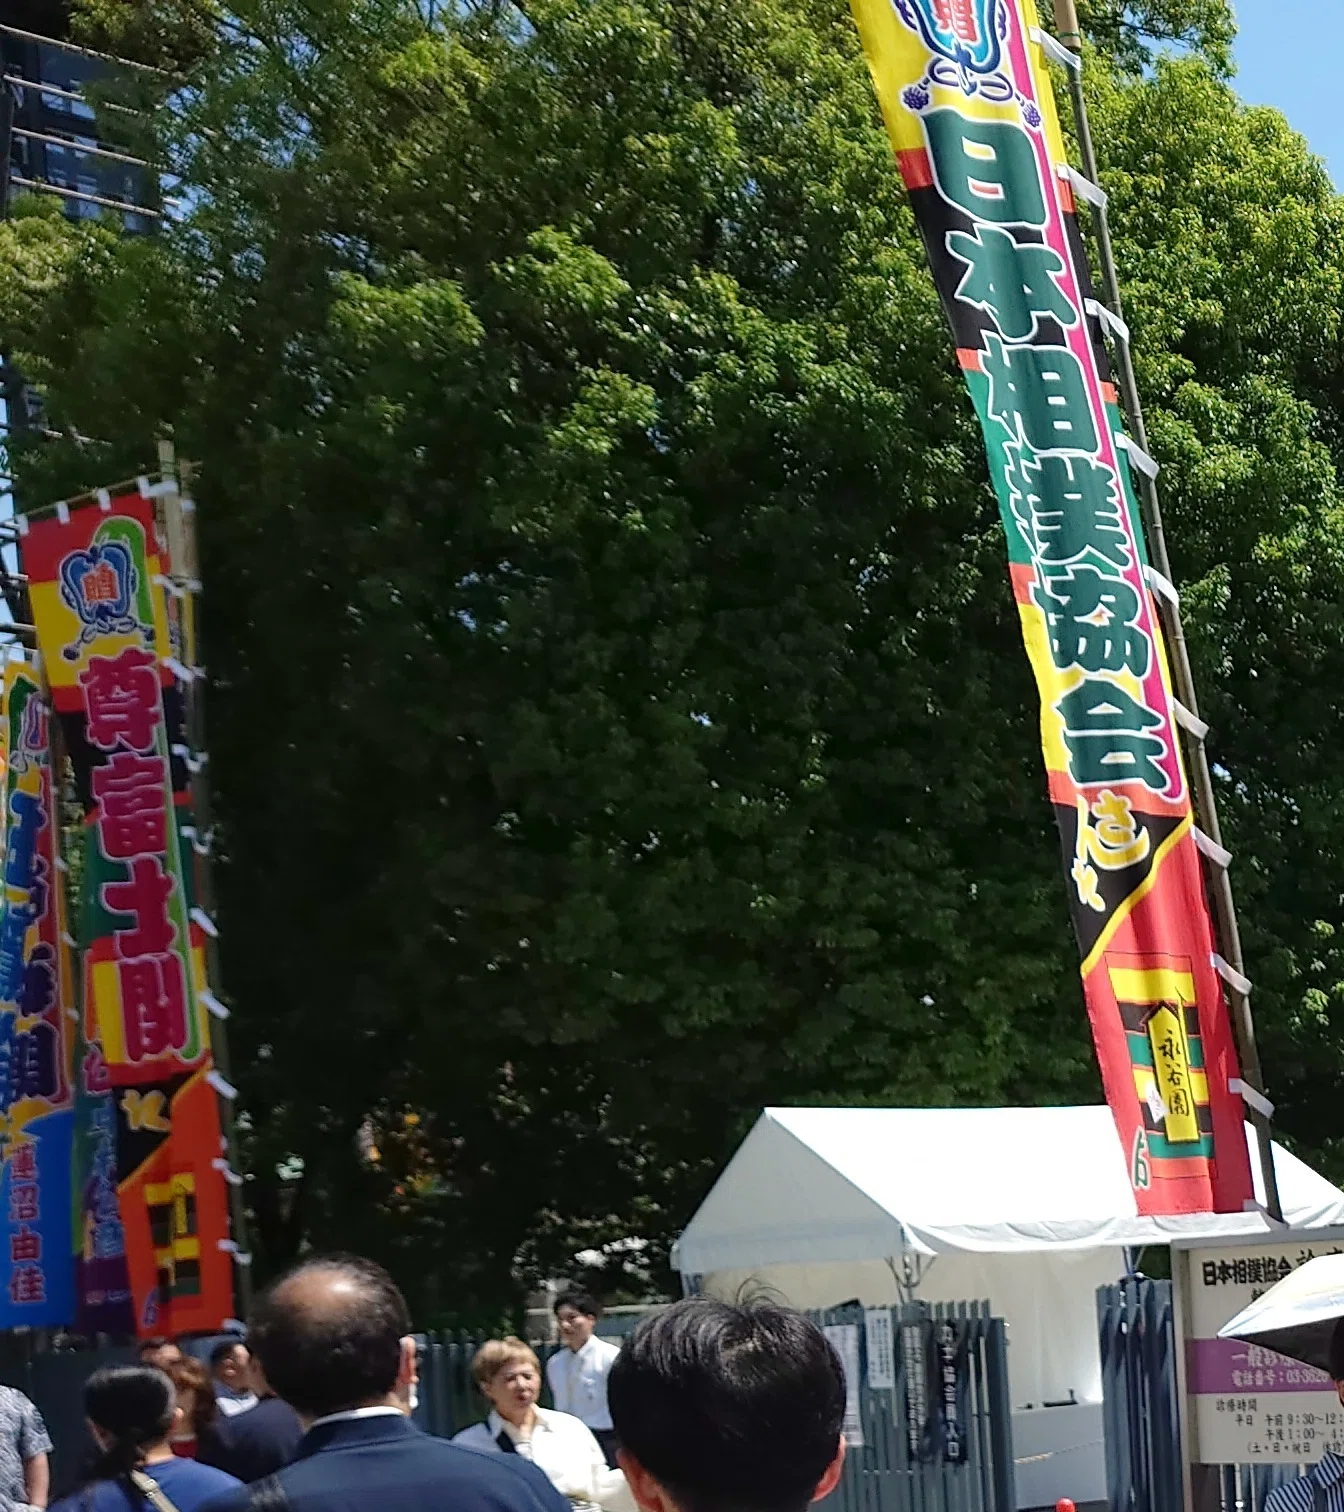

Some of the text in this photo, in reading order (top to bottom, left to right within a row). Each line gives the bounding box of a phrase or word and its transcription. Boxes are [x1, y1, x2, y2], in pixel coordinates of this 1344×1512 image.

[920, 108, 1171, 793] 日本相撲協会
